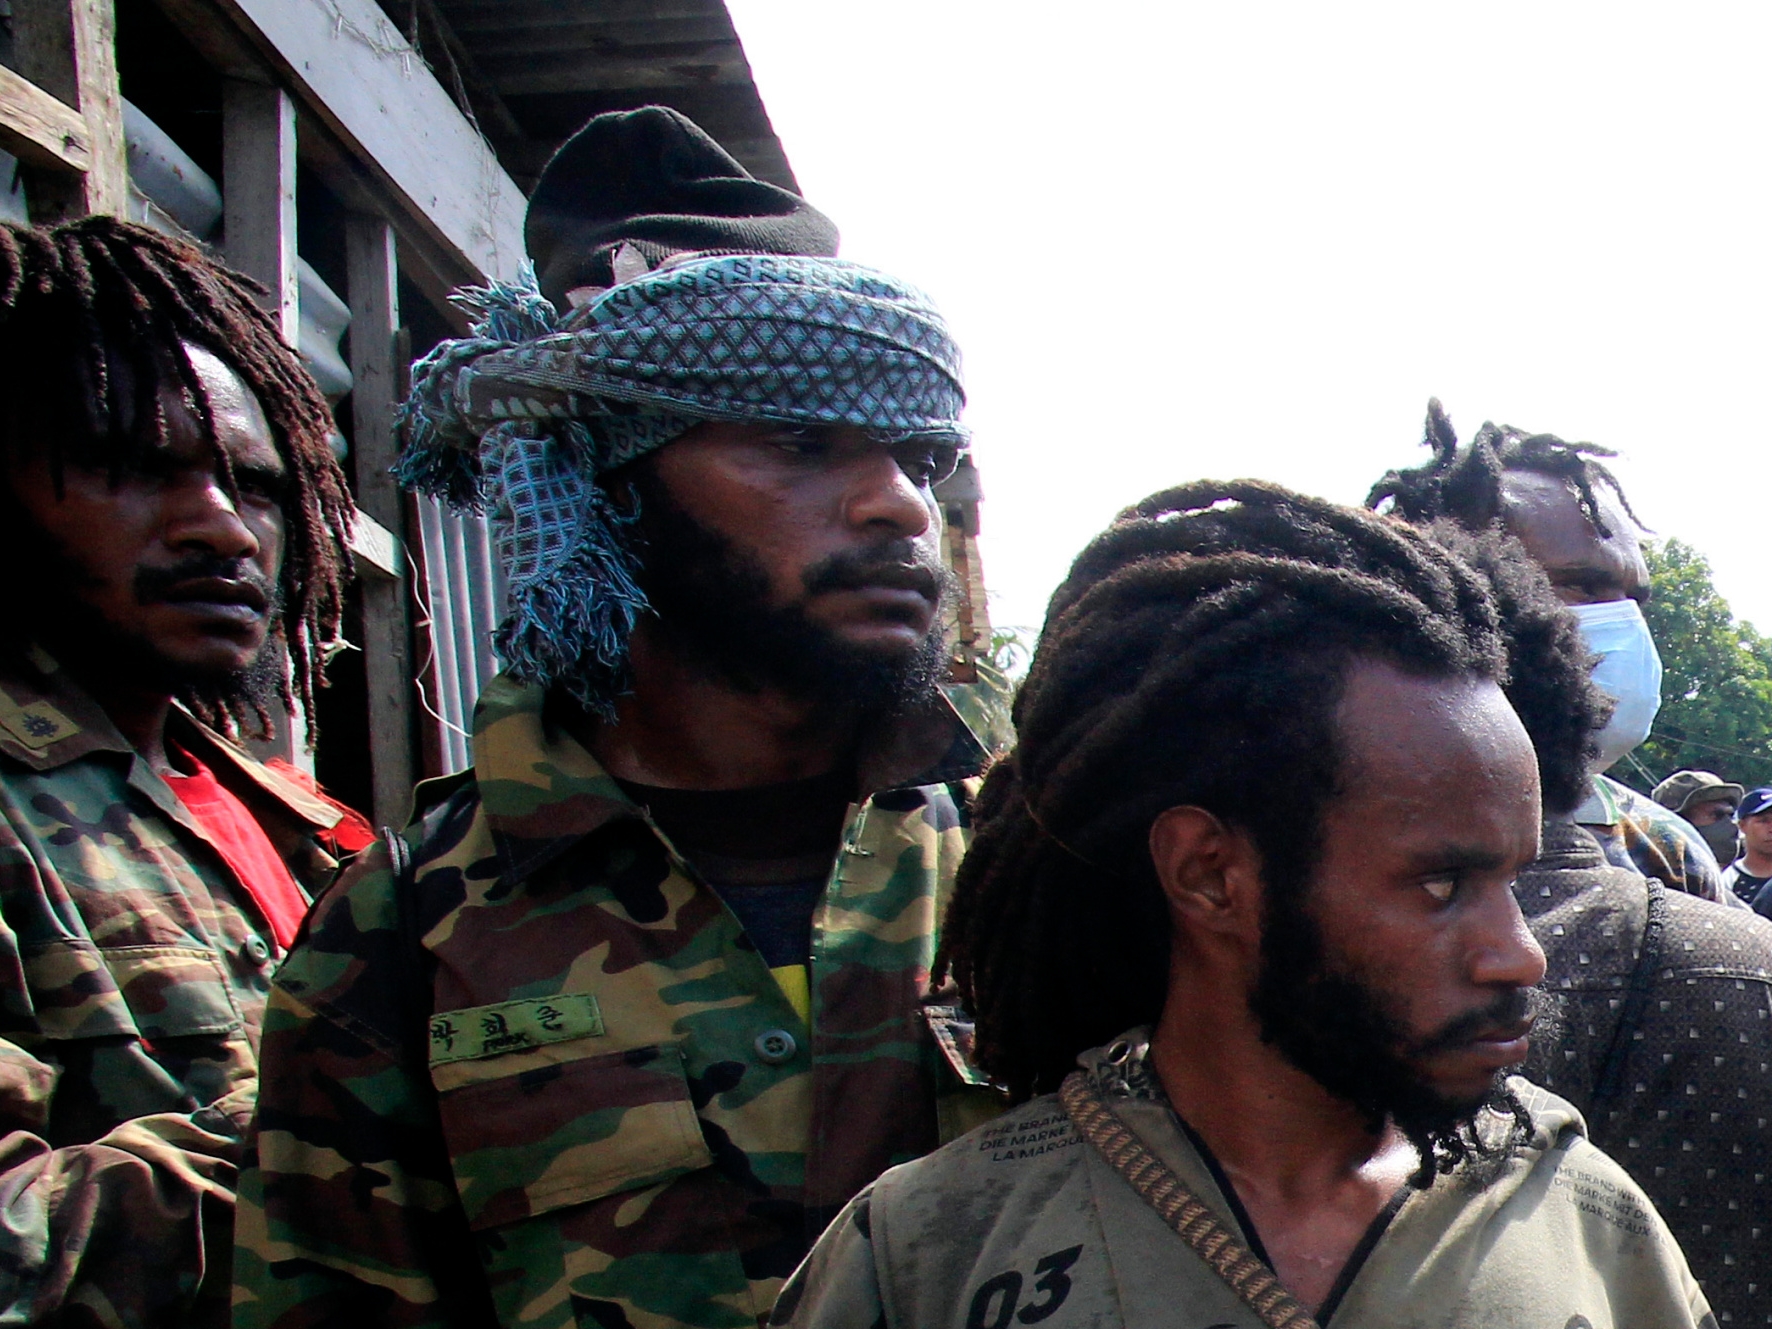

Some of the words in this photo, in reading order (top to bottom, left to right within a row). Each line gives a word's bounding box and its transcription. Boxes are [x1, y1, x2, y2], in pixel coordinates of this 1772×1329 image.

[979, 1139, 1007, 1152] DIE
[1010, 1125, 1070, 1147] MARKE
[992, 1150, 1016, 1162] LA
[1577, 1171, 1616, 1193] BRAND
[1574, 1182, 1613, 1207] MARKE
